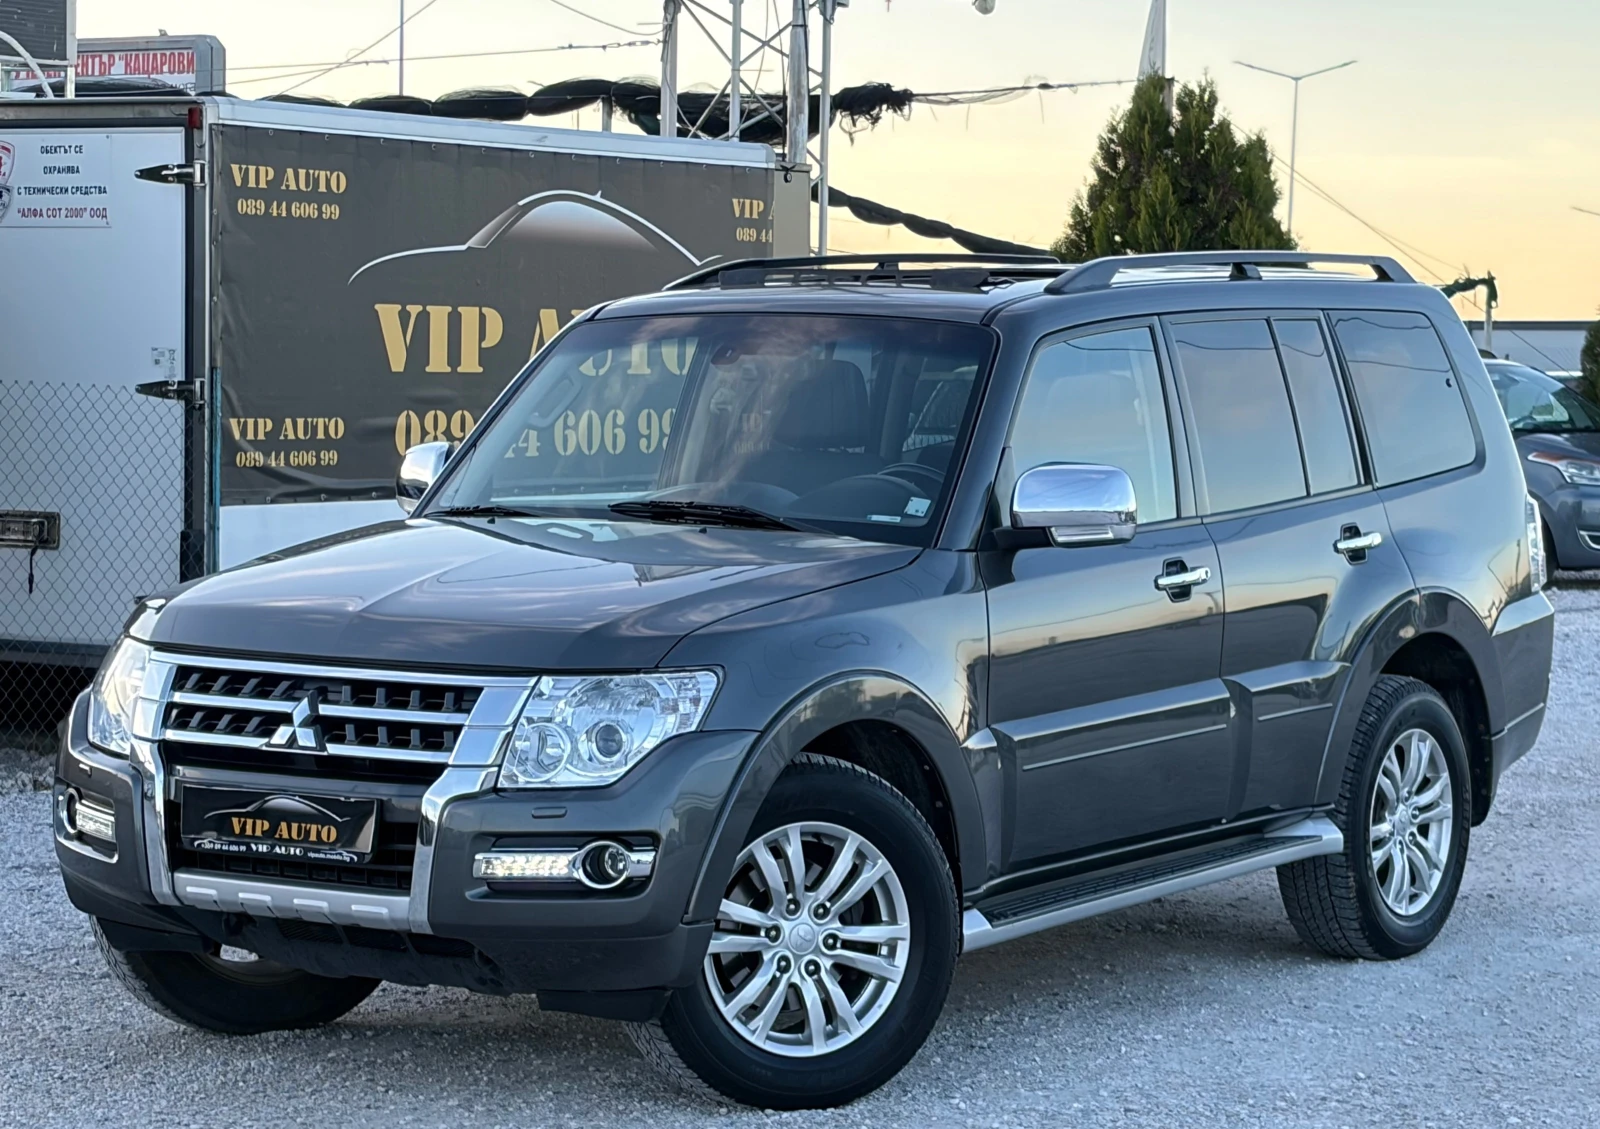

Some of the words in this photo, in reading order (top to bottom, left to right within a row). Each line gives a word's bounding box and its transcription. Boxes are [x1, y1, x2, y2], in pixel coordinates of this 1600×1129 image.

[75, 53, 116, 76] ЕНТЪР
[40, 145, 73, 154] ОБЕКТЪТ
[74, 145, 83, 154] СЕ
[43, 165, 80, 175] ОХРАНЯВА
[230, 164, 275, 189] VIP
[280, 168, 347, 194] AUTO
[17, 187, 22, 195] С
[24, 186, 69, 195] ТЕХНИЧЕСКИ
[70, 186, 107, 196] СРЕДСТВА
[46, 207, 62, 218] СОТ
[89, 207, 108, 220] ООД
[237, 198, 266, 216] 089
[269, 200, 287, 217] 44
[291, 202, 319, 219] 606
[321, 203, 340, 220] 99
[732, 198, 765, 219] VIP
[736, 227, 757, 242] 089
[759, 228, 773, 243] 44
[374, 303, 504, 374] VIP
[229, 418, 273, 441] VIP
[278, 417, 345, 440] AUTO
[394, 409, 475, 457] 089
[553, 408, 626, 457] 606
[236, 451, 264, 468] 089
[267, 451, 286, 467] 44
[289, 450, 317, 467] 606
[319, 449, 338, 466] 99
[231, 816, 270, 837] VIP
[274, 821, 337, 843] AUTO
[250, 843, 271, 853] VIP
[272, 845, 304, 856] AUTO
